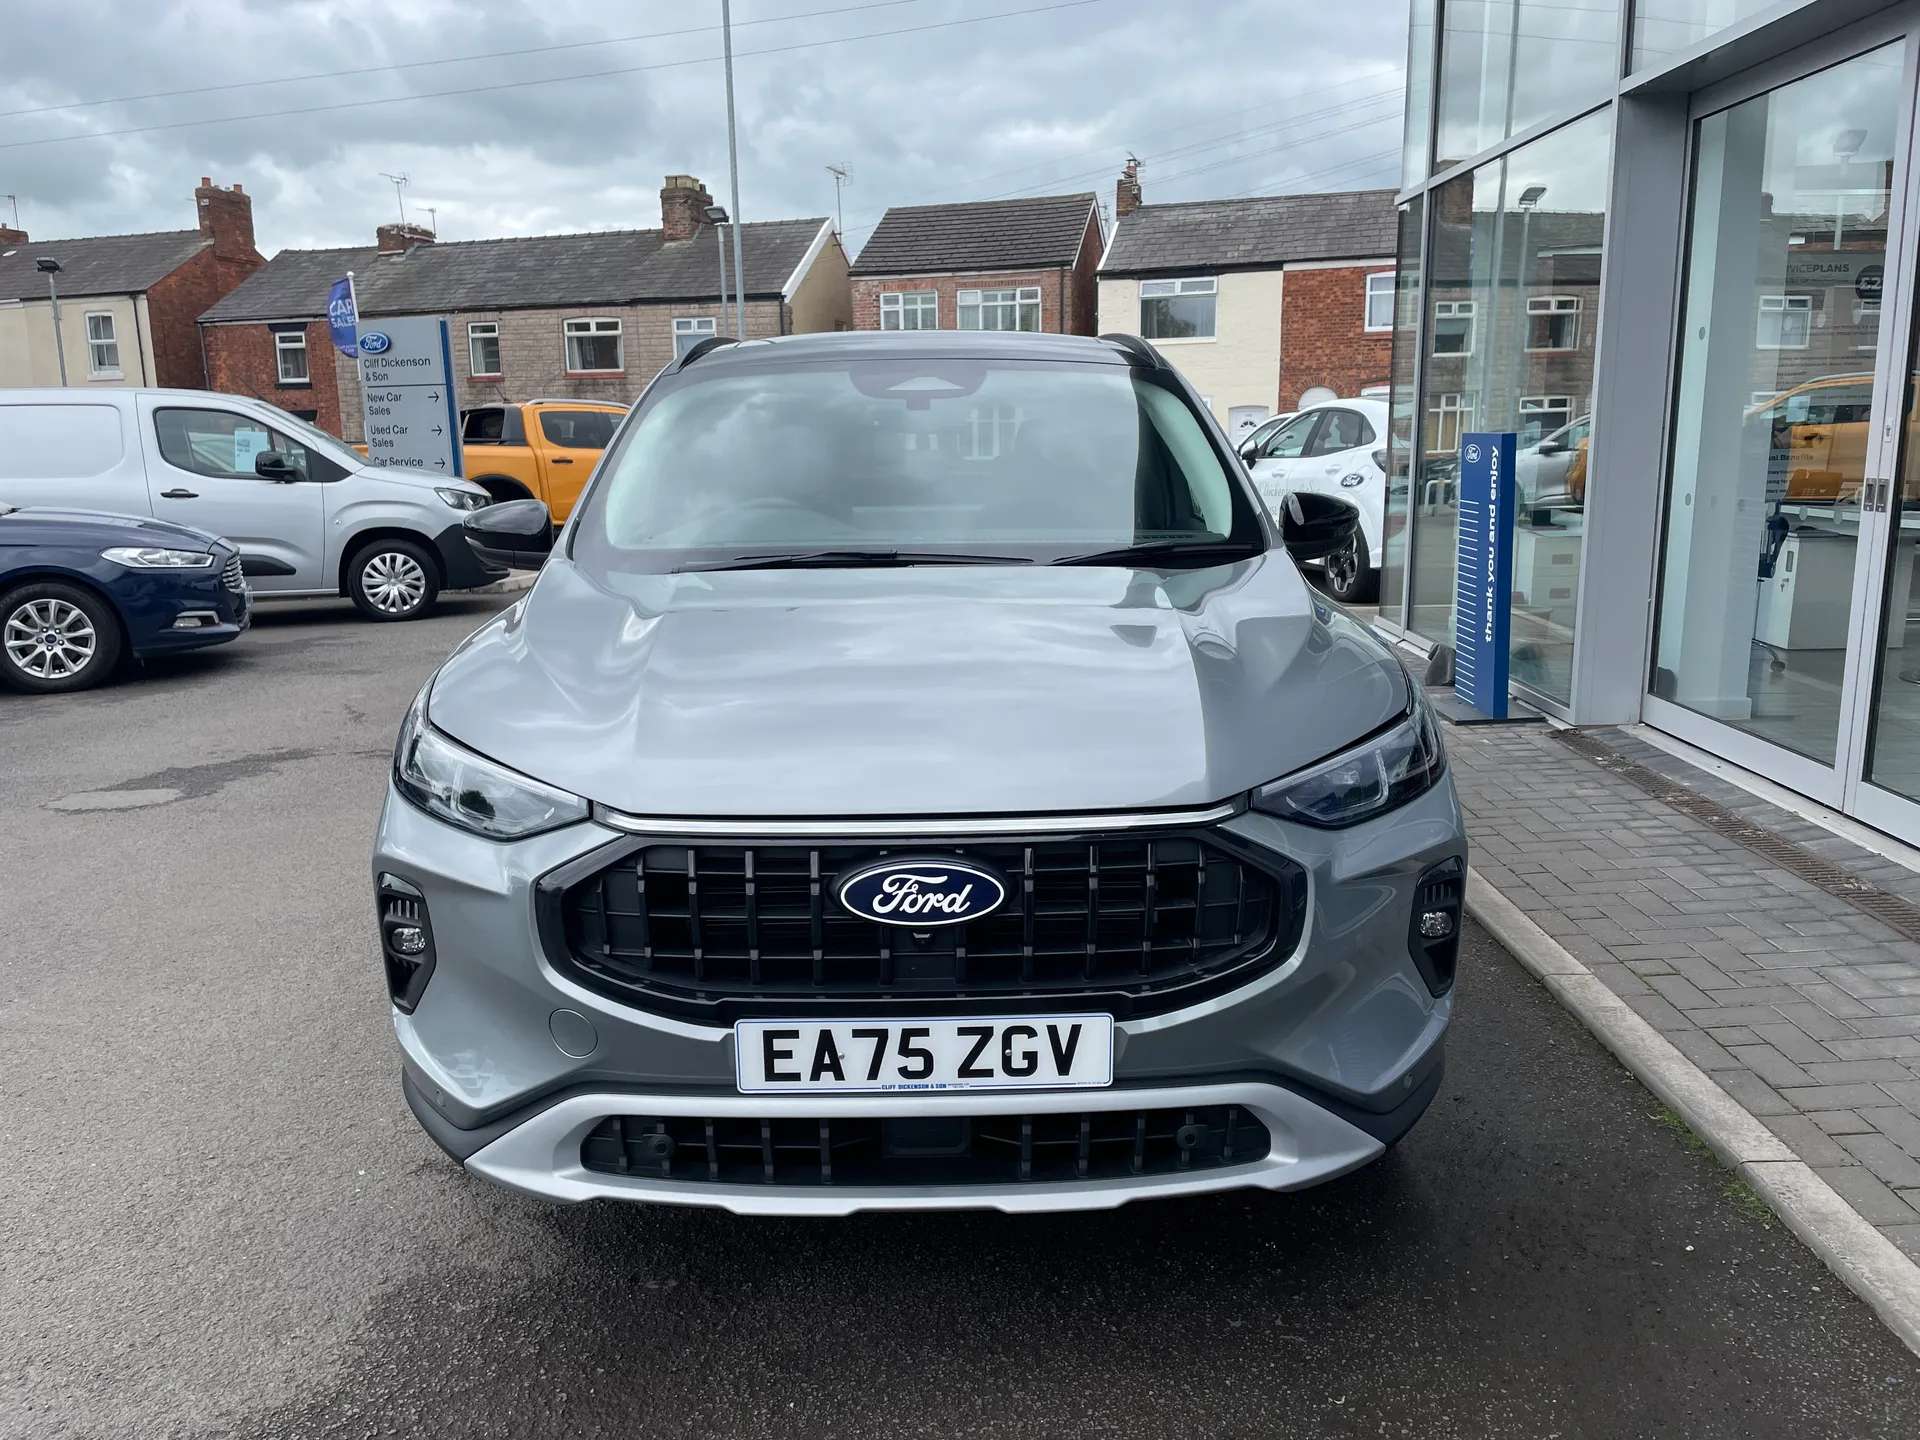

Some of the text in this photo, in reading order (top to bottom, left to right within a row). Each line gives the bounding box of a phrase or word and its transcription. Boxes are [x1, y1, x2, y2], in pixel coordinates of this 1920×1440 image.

[329, 298, 354, 316] CAR
[364, 357, 431, 369] Cliff Dickenson
[365, 372, 389, 382] & Son
[367, 391, 402, 402] New Car
[368, 406, 391, 416] Sales
[371, 423, 408, 435] Used Car
[372, 437, 394, 448] Sales
[374, 456, 424, 467] Car Service
[1485, 445, 1499, 643] thank you and enjoy
[872, 874, 973, 914] Ford
[762, 1024, 1083, 1082] EA75 ZGV
